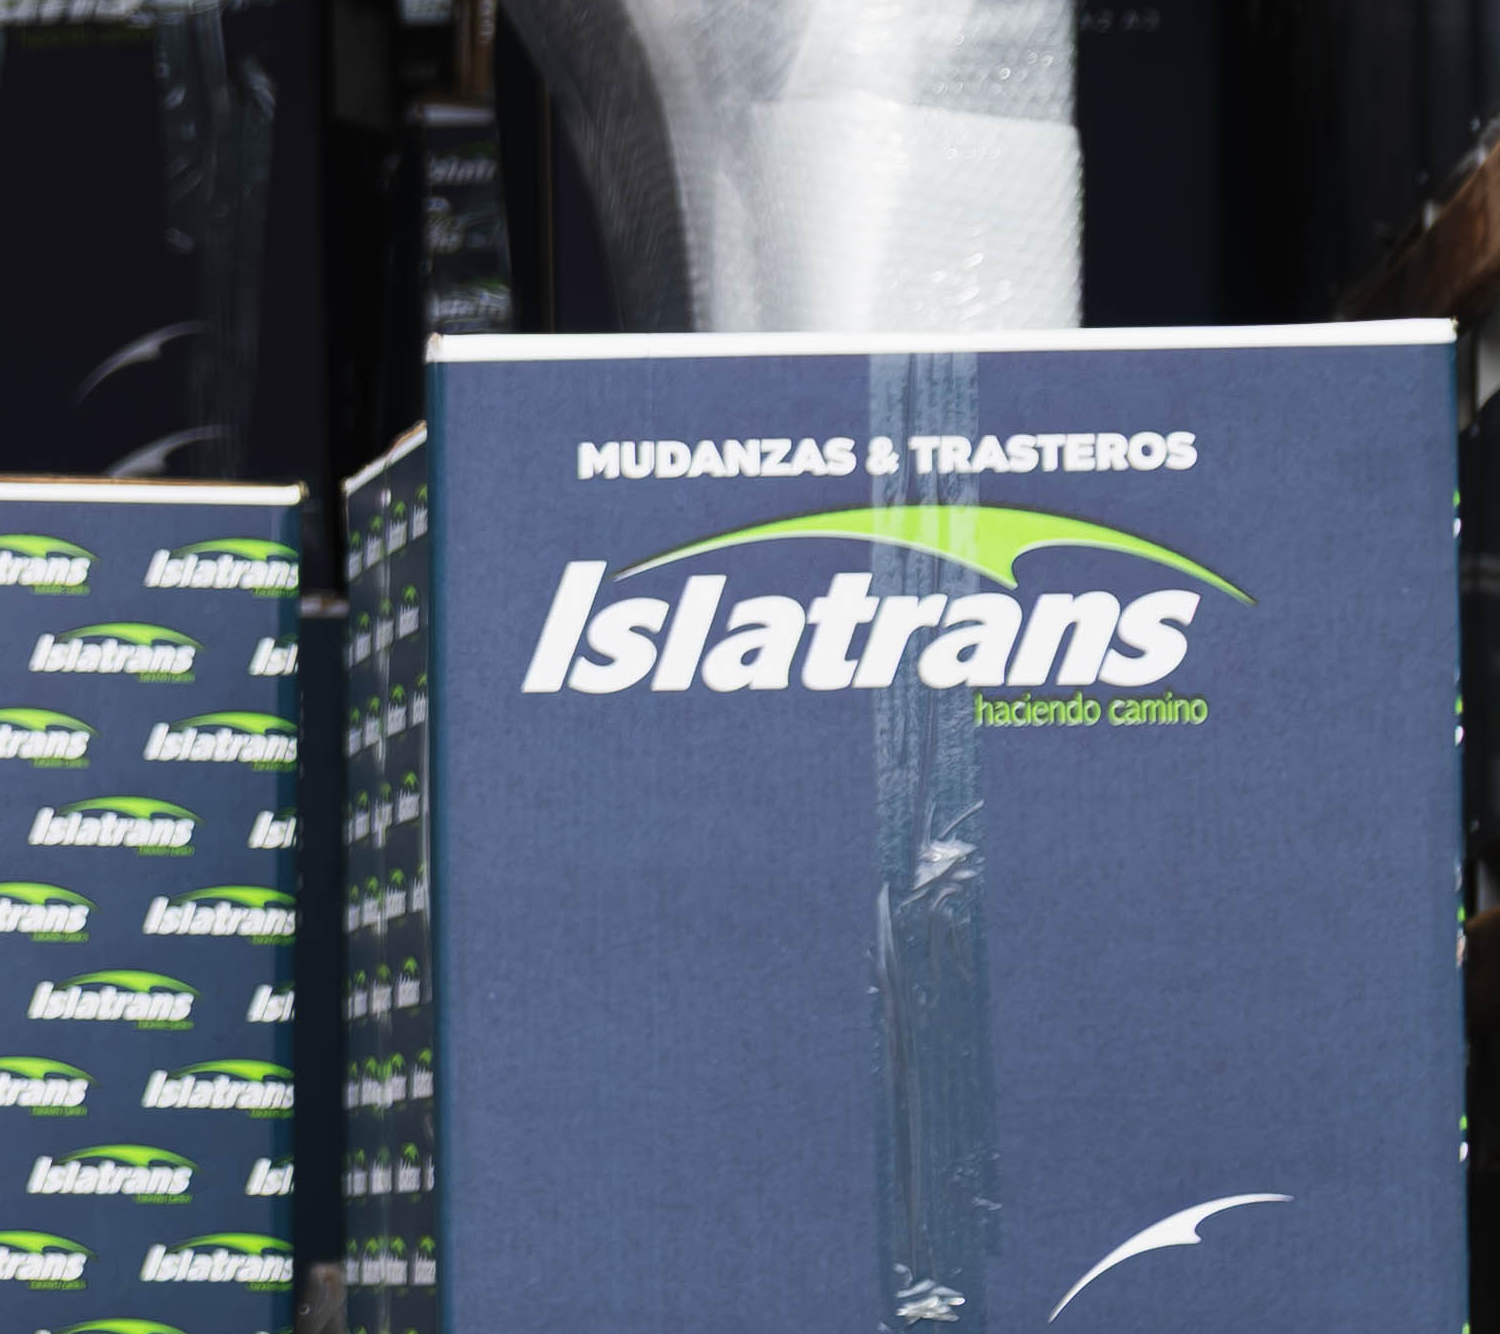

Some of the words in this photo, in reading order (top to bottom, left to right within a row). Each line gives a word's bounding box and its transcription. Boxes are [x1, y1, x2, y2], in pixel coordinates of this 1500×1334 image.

[577, 436, 858, 480] MUDANZAS
[865, 435, 901, 476] &
[909, 431, 1199, 474] TRASTEROS
[521, 559, 1202, 694] Islatrans
[28, 632, 198, 675] Islatrans
[974, 691, 1102, 728] haciendo
[1108, 692, 1209, 726] camino
[27, 806, 196, 849] Islatrans
[27, 979, 196, 1022] Islatrans
[27, 1154, 194, 1197] Islatrans
